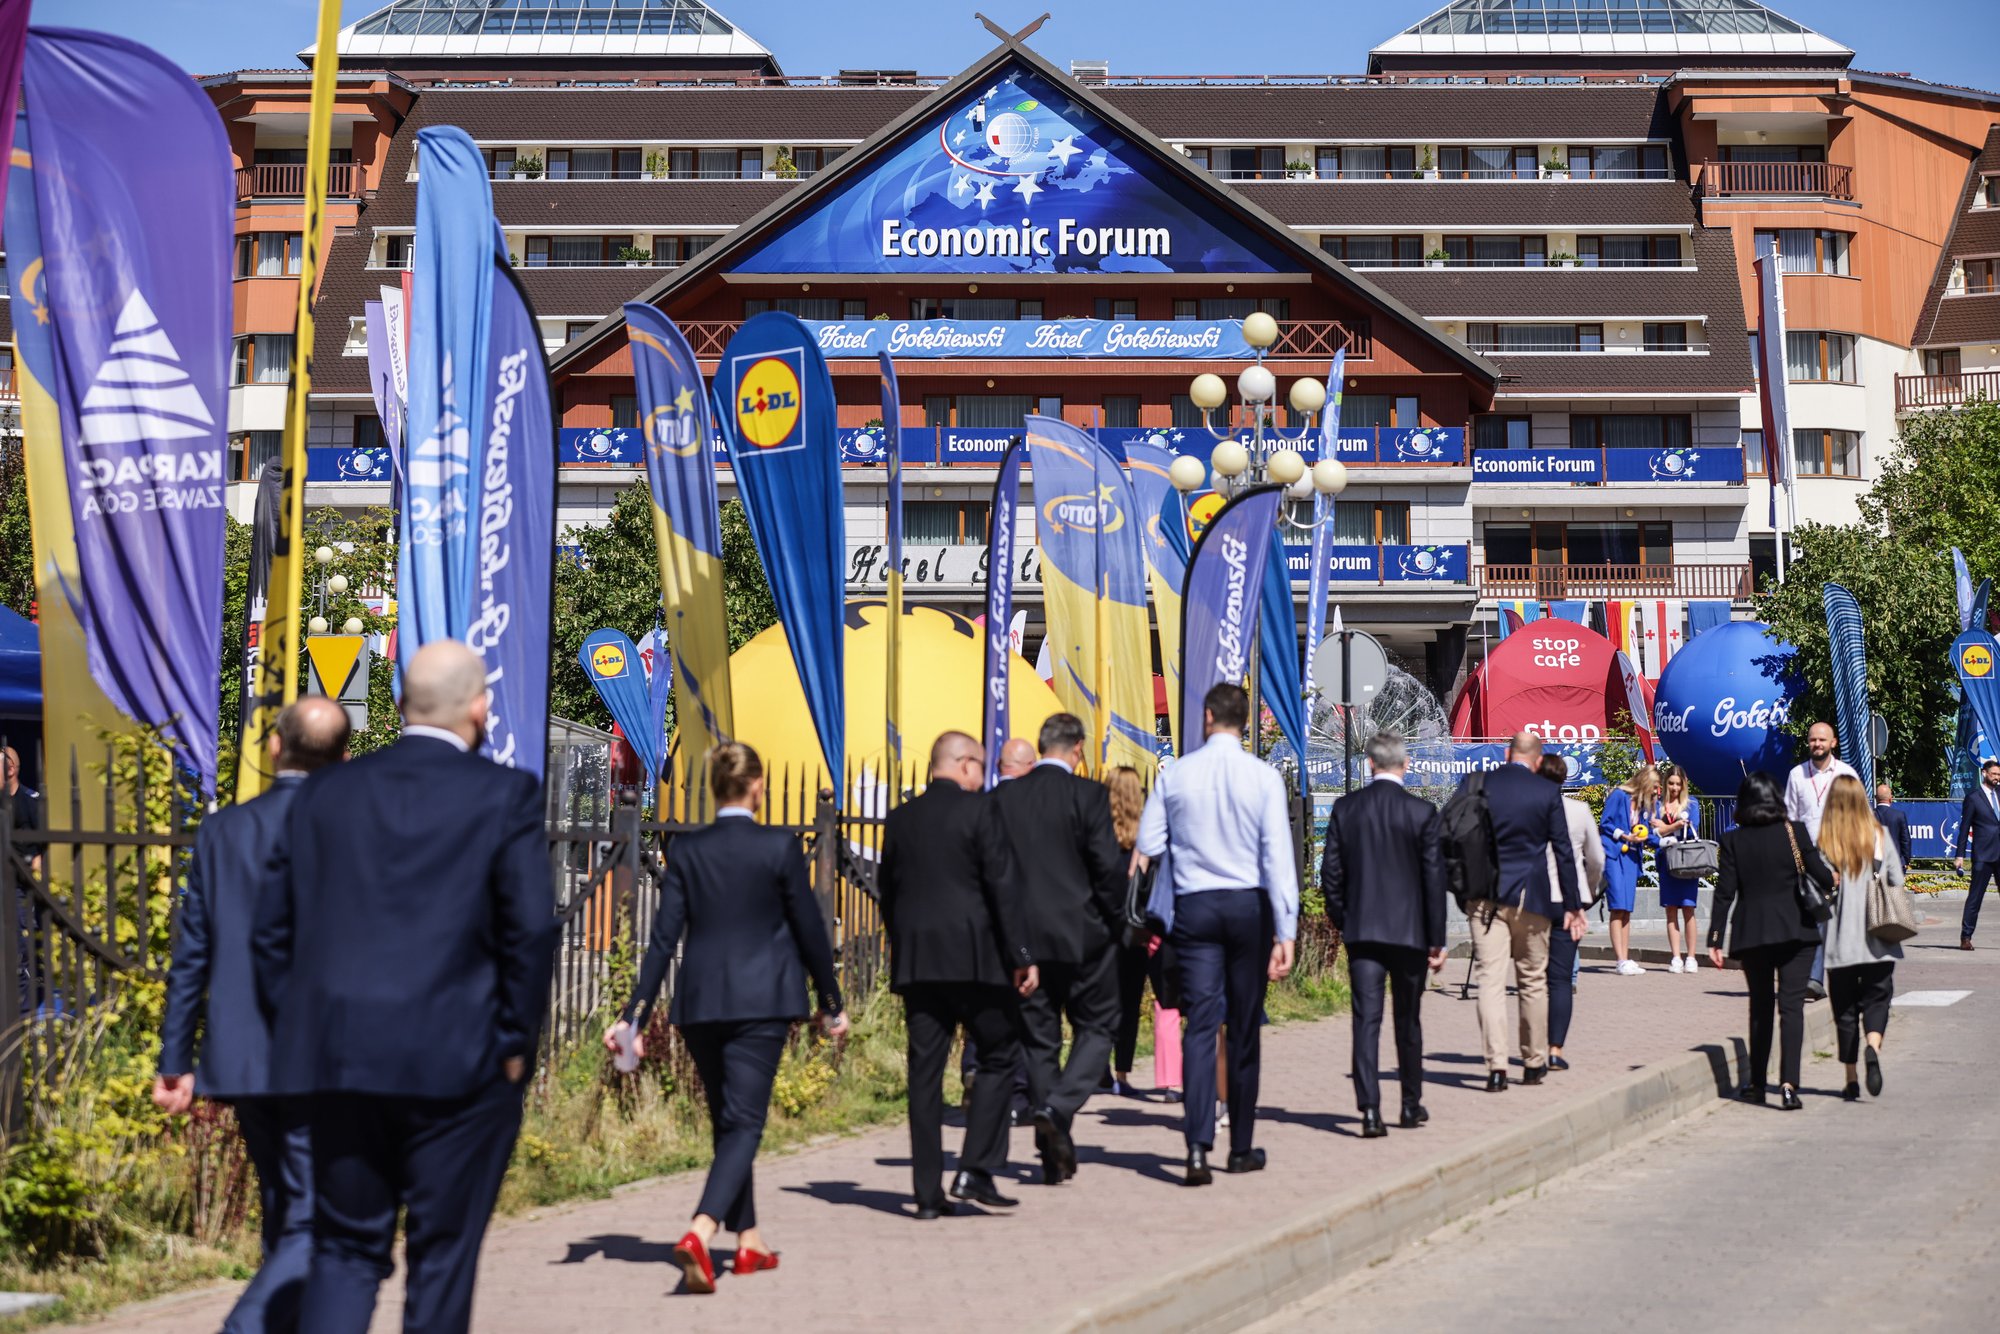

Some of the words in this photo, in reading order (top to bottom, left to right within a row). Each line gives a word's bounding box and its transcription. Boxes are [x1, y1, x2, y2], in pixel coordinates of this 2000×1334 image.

[882, 218, 1050, 257] Economic
[1058, 218, 1171, 256] Forum
[818, 325, 876, 349] Hotel
[887, 323, 1006, 353] Gołębiewski
[1026, 325, 1092, 349] Hotel
[1103, 323, 1221, 353] Gołębiewski
[949, 434, 1021, 452] Econom
[1318, 436, 1368, 452] rum
[1474, 456, 1545, 473] Economic
[1547, 456, 1596, 473] Forum
[1329, 556, 1372, 571] orum
[1216, 533, 1248, 683] łębiewski
[1532, 637, 1579, 654] stop
[1533, 652, 1581, 669] cafe
